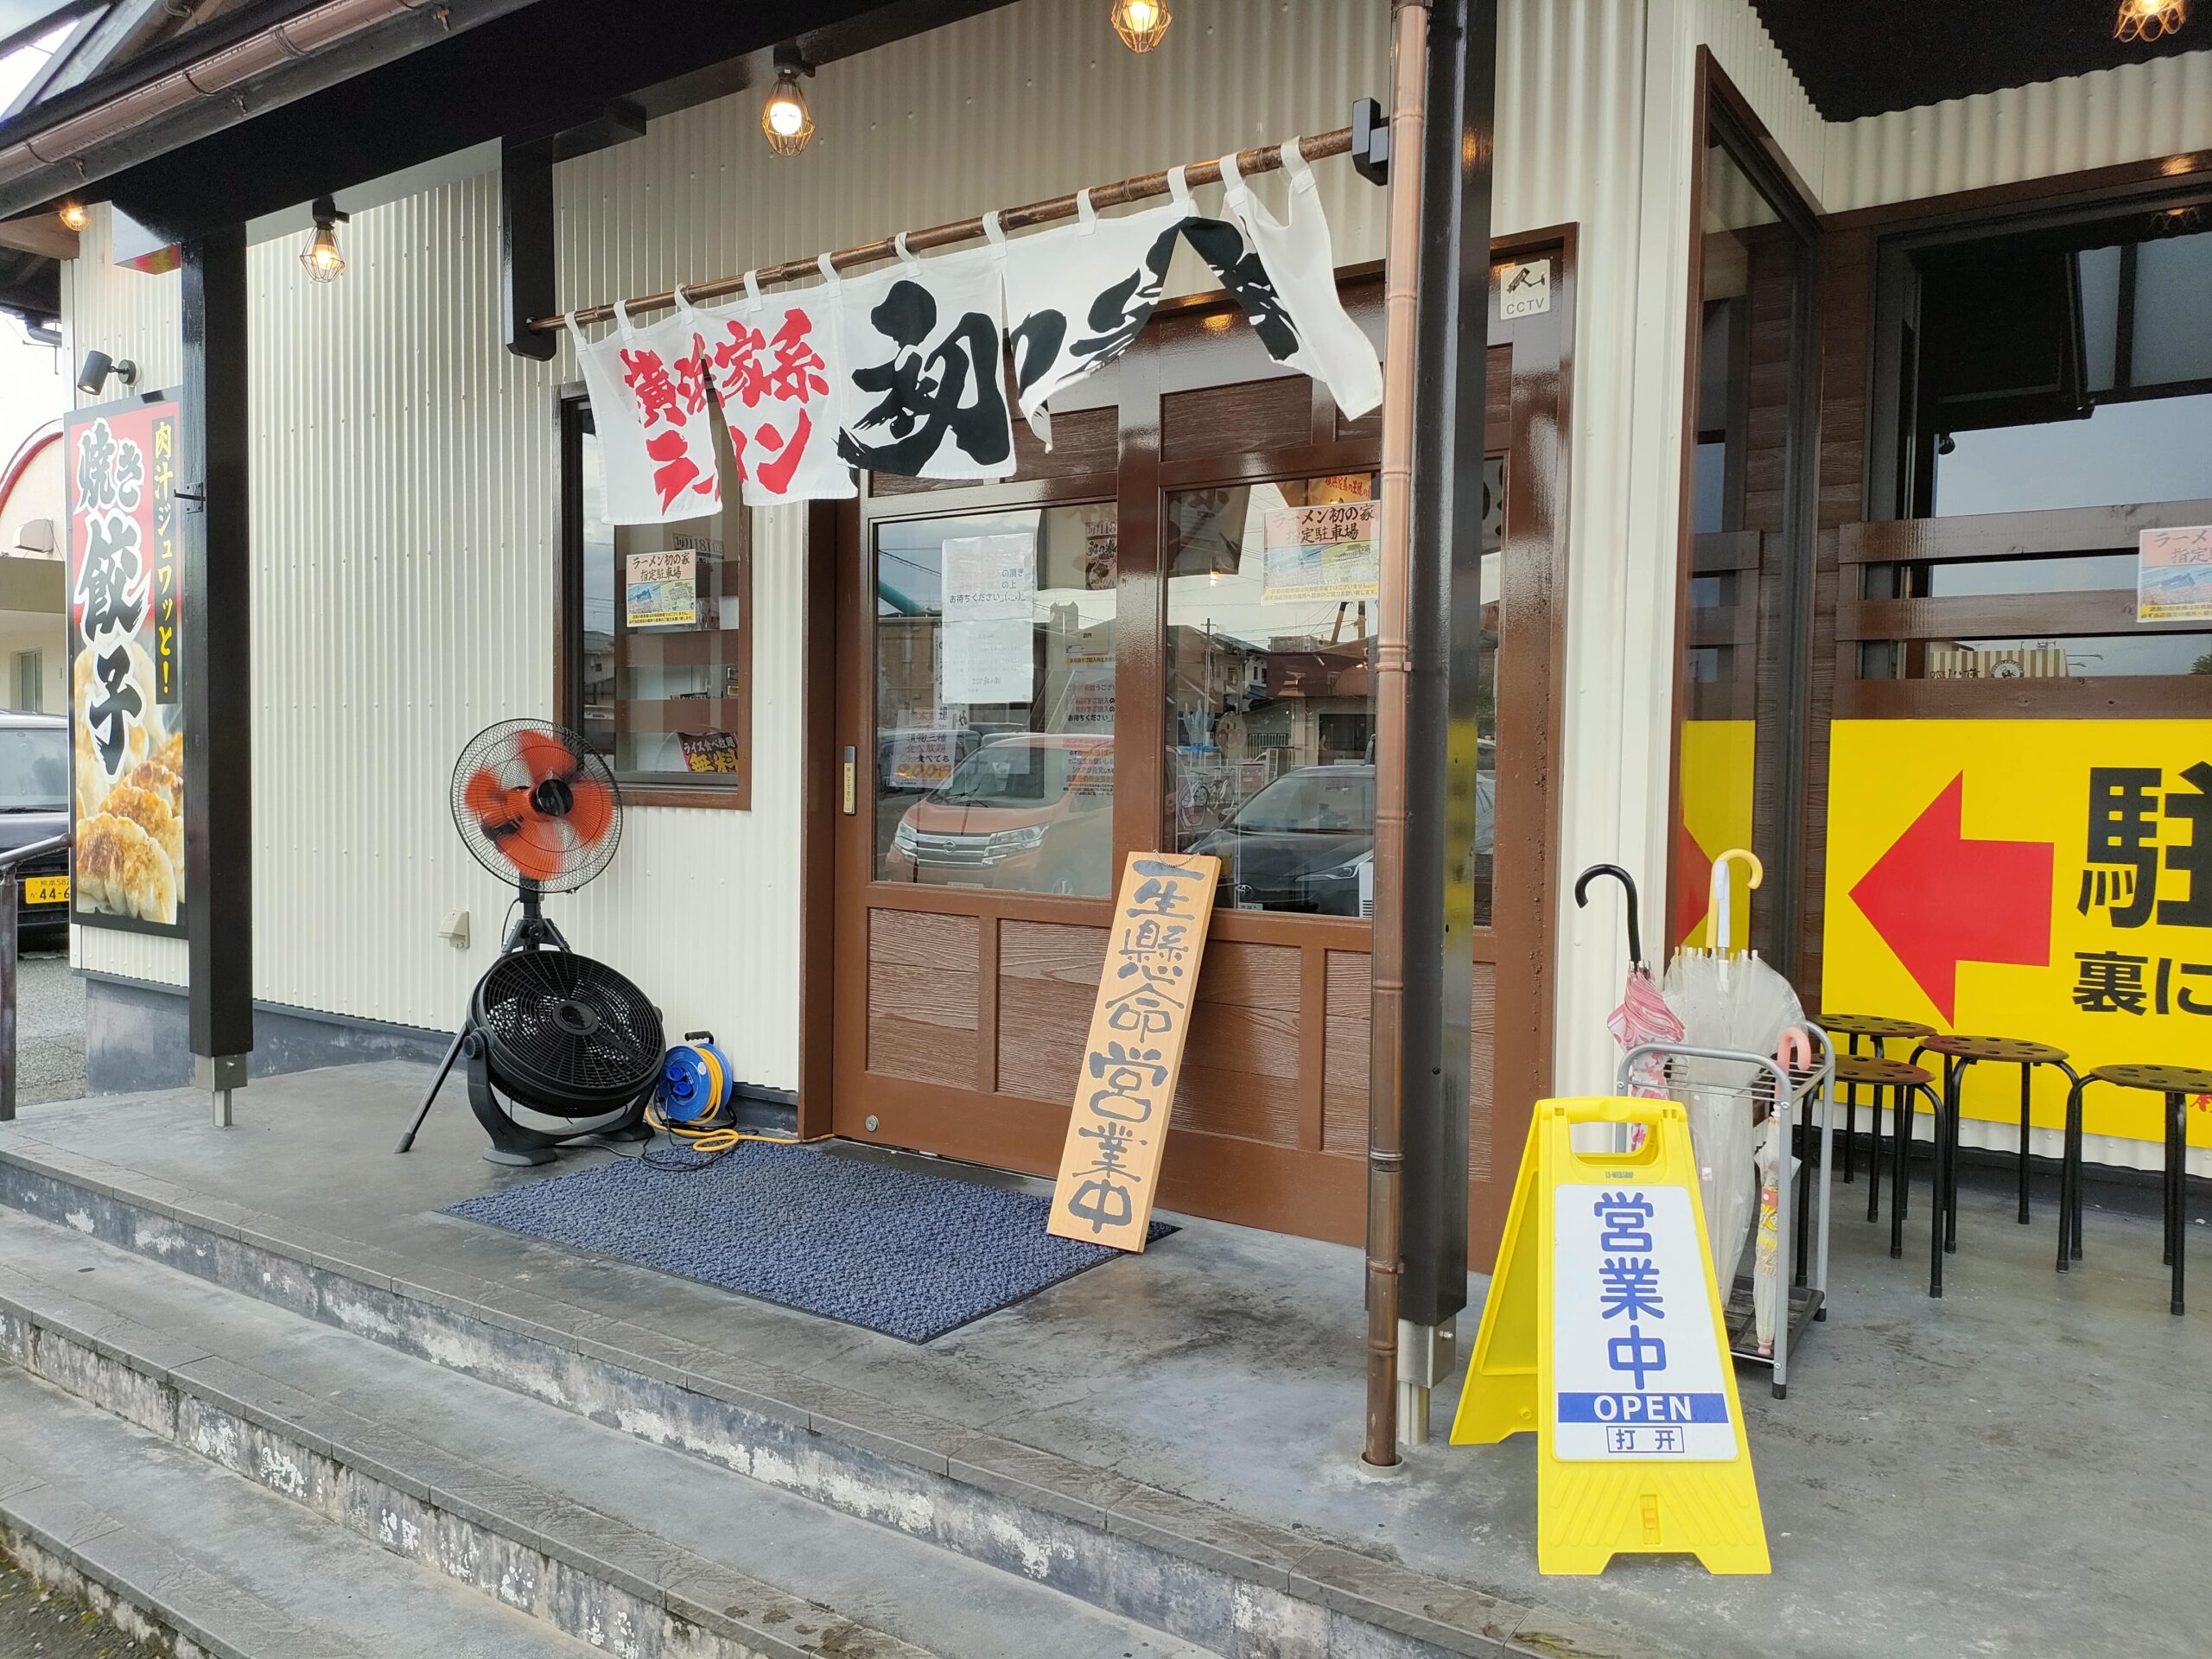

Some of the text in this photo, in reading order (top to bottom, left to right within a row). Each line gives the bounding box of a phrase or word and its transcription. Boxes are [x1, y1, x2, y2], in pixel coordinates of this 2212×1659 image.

[1506, 297, 1545, 315] CCTV
[1272, 504, 1376, 529] ラーメン初の家
[1286, 523, 1359, 545] 指定駐車場
[2154, 529, 2208, 548] ラーメ
[632, 552, 690, 569] ラーメン初の家
[2171, 546, 2212, 564] 指定
[640, 566, 682, 582] 指定駐車場
[75, 419, 149, 780] 焼き餃子
[39, 887, 69, 900] 44-6
[2072, 950, 2212, 1017] 裏に
[1593, 1191, 1666, 1390] 営業中
[1594, 1395, 1694, 1421] OPEN
